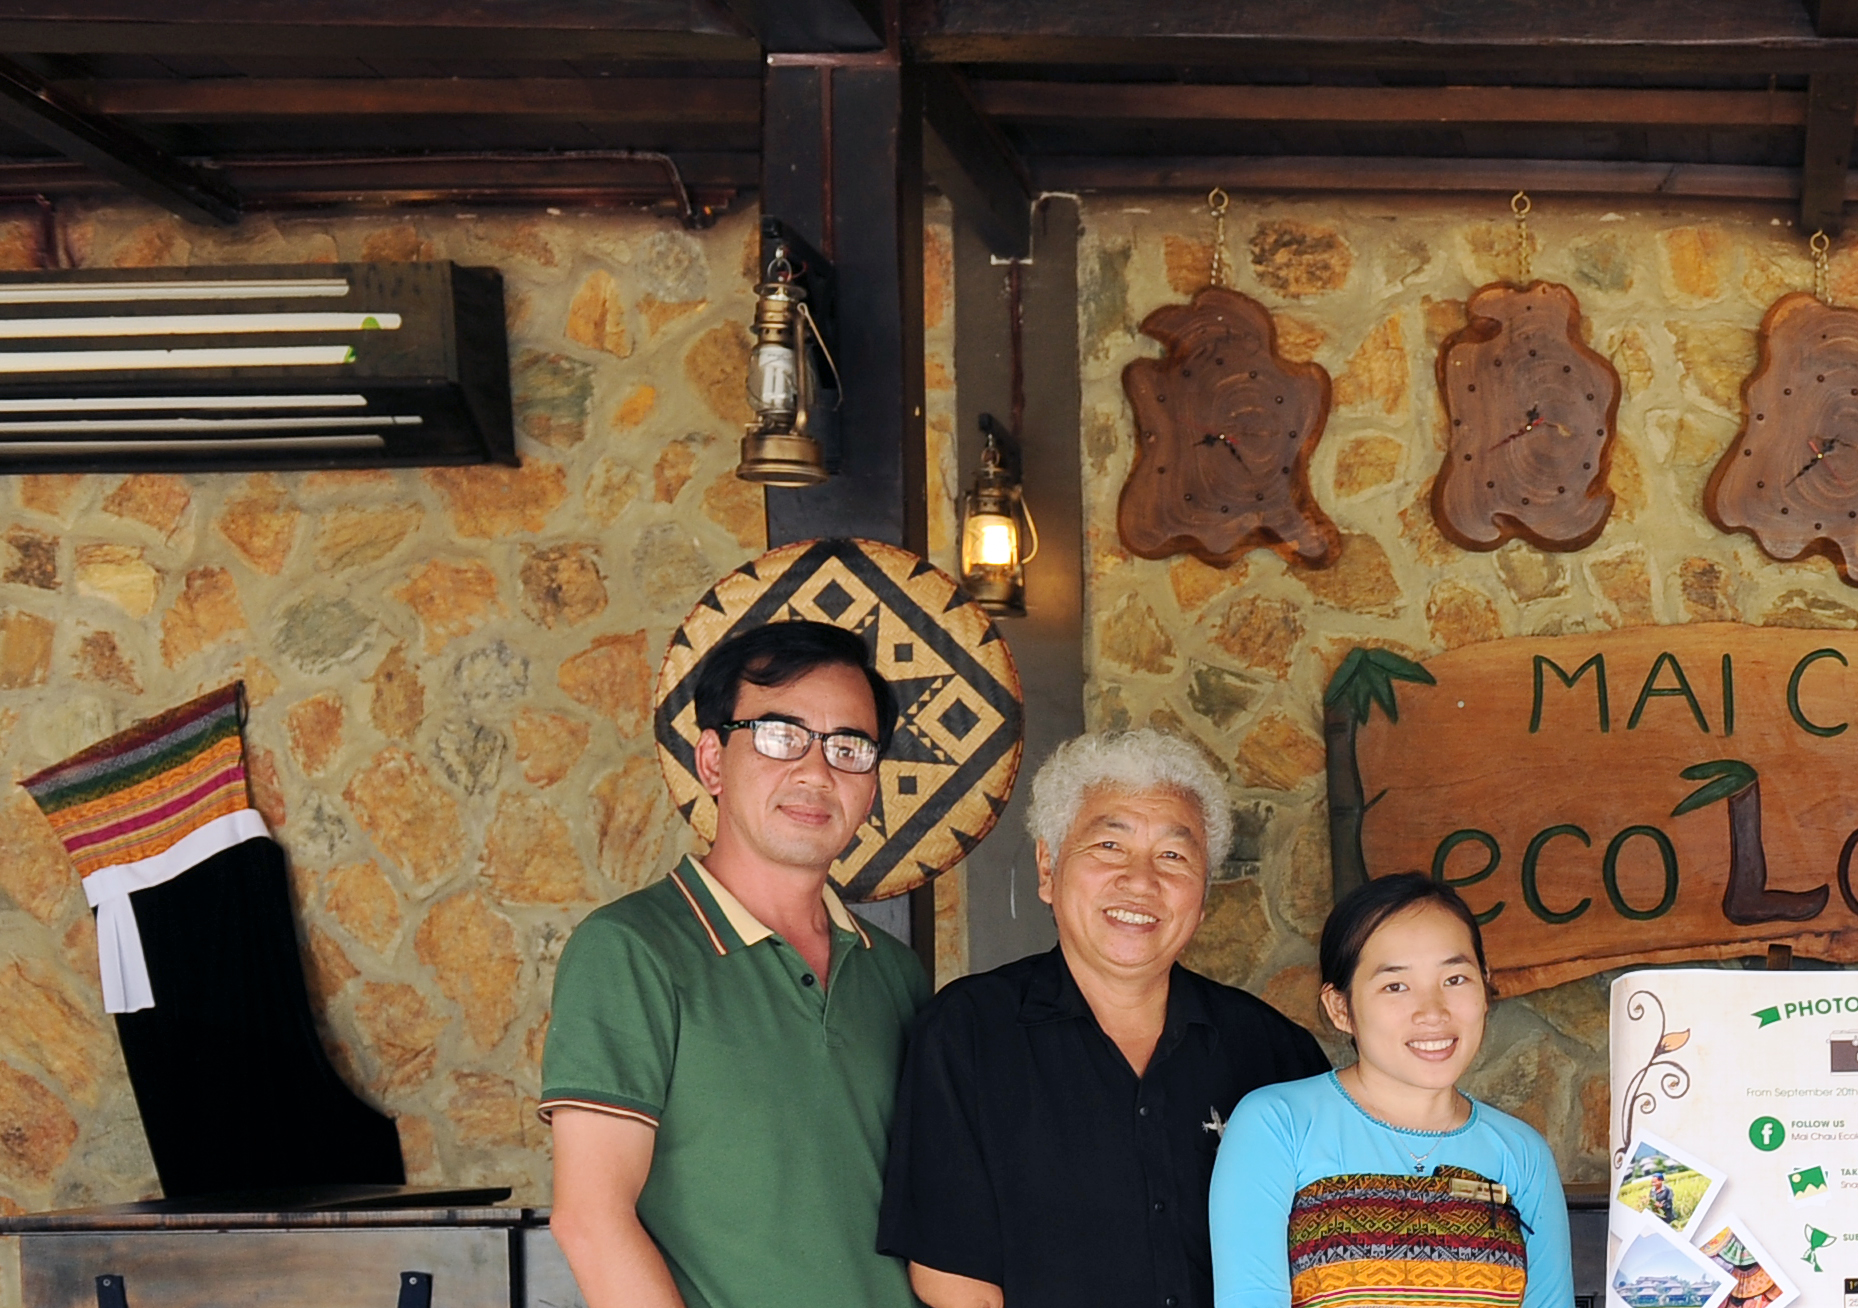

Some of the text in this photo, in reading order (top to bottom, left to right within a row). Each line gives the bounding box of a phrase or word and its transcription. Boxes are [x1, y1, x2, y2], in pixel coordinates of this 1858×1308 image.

[1528, 650, 1735, 737] MAI
[1746, 1088, 1772, 1097] From
[1774, 1087, 1833, 1098] September
[1836, 1087, 1858, 1096] 20th
[1791, 1120, 1845, 1128] FOLLOW US
[1791, 1132, 1808, 1140] Mai
[1811, 1132, 1836, 1140] Chau
